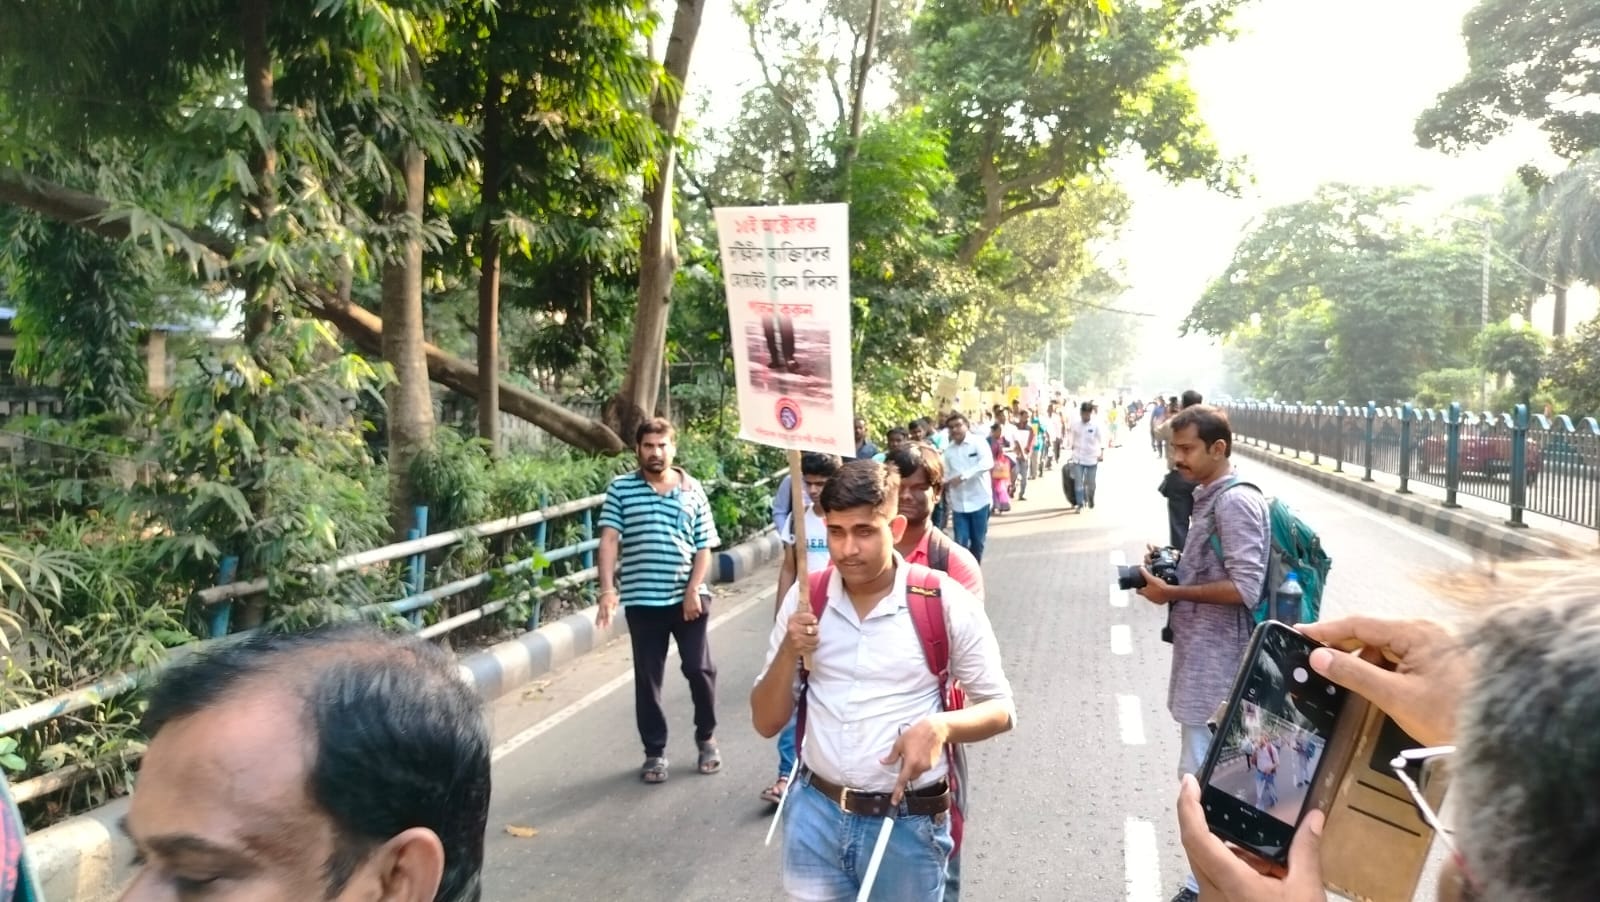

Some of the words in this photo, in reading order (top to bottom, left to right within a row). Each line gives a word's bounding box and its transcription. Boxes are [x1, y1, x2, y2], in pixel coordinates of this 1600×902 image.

[760, 214, 817, 234] অক্টোবর
[766, 240, 830, 263] ব্যক্তিদের
[770, 275, 799, 291] কেন
[802, 269, 839, 290] দিবস
